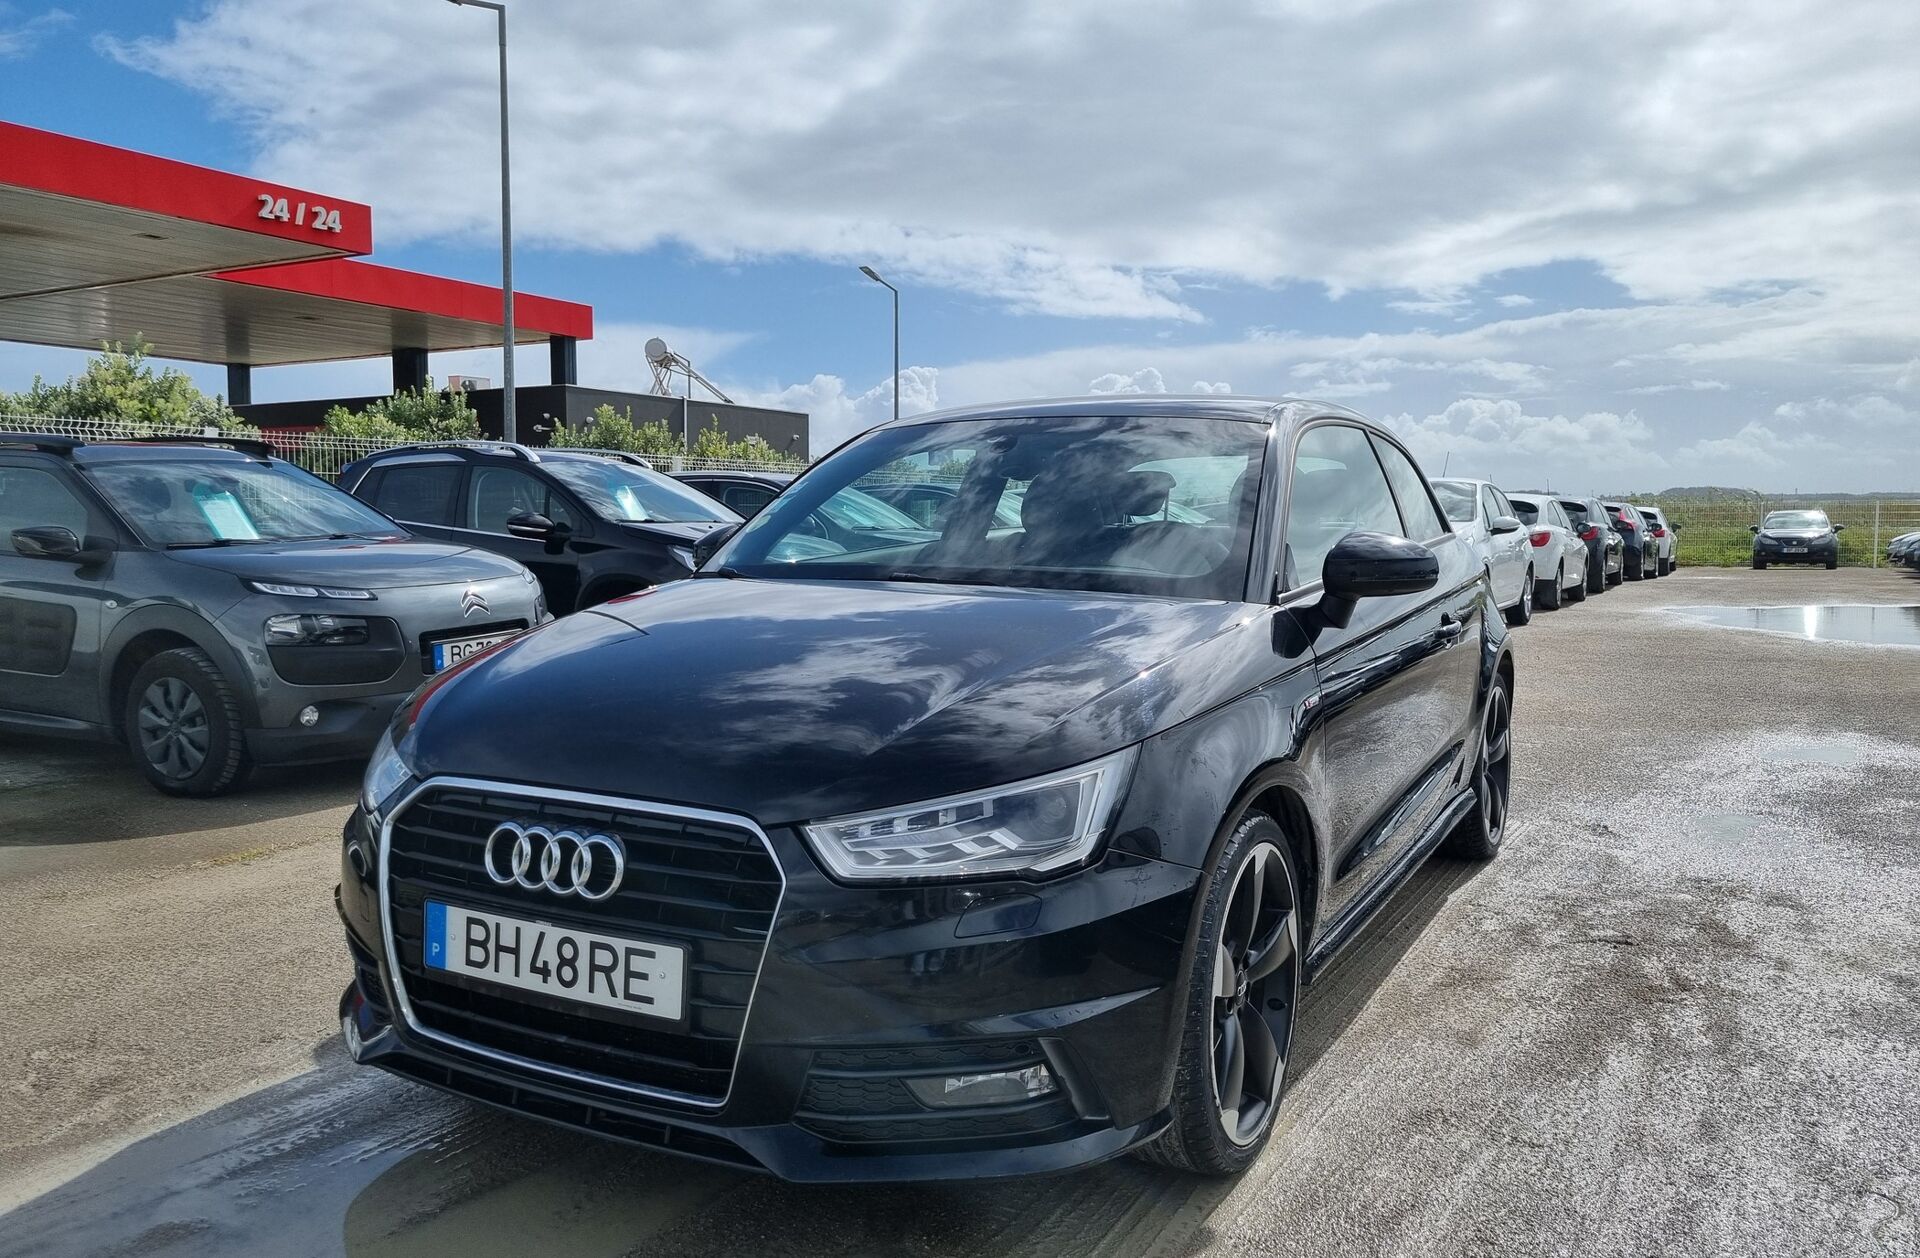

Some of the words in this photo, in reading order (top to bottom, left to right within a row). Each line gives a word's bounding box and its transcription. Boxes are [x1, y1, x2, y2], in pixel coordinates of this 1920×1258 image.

[258, 193, 290, 222] 24
[312, 206, 342, 233] 24
[432, 943, 440, 956] P
